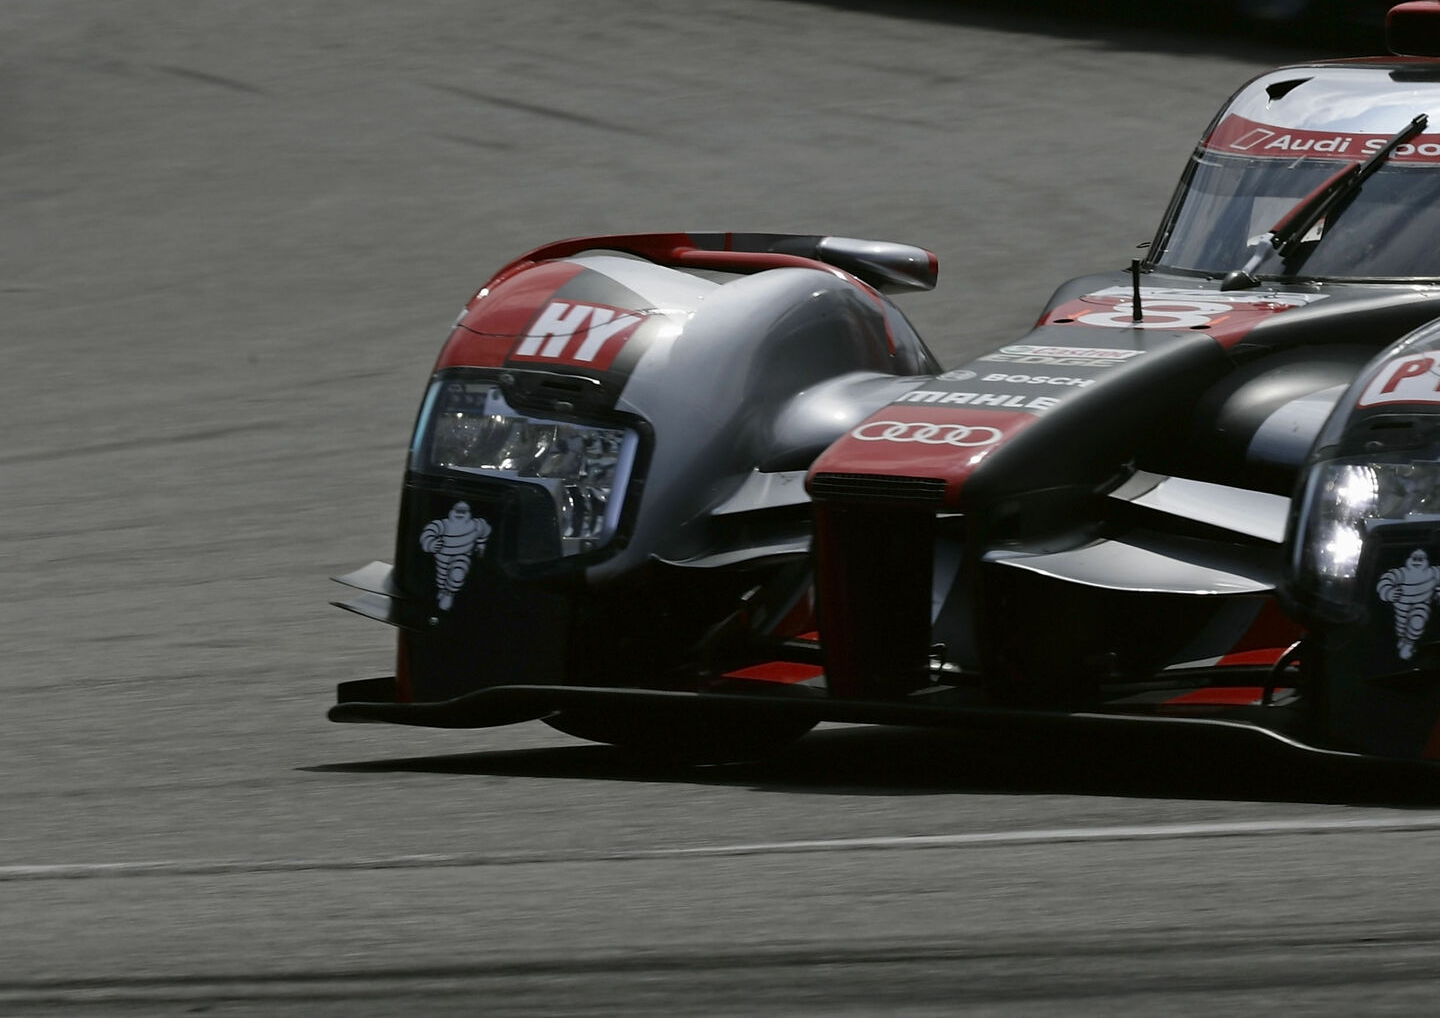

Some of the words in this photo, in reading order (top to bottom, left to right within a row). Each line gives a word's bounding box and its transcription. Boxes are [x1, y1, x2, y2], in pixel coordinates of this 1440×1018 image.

[1265, 134, 1353, 154] Audi
[1077, 301, 1233, 329] 8
[516, 302, 642, 362] HY
[977, 354, 1127, 367] EDGE
[981, 373, 1096, 388] BOSCH
[898, 391, 1062, 411] MAHLE
